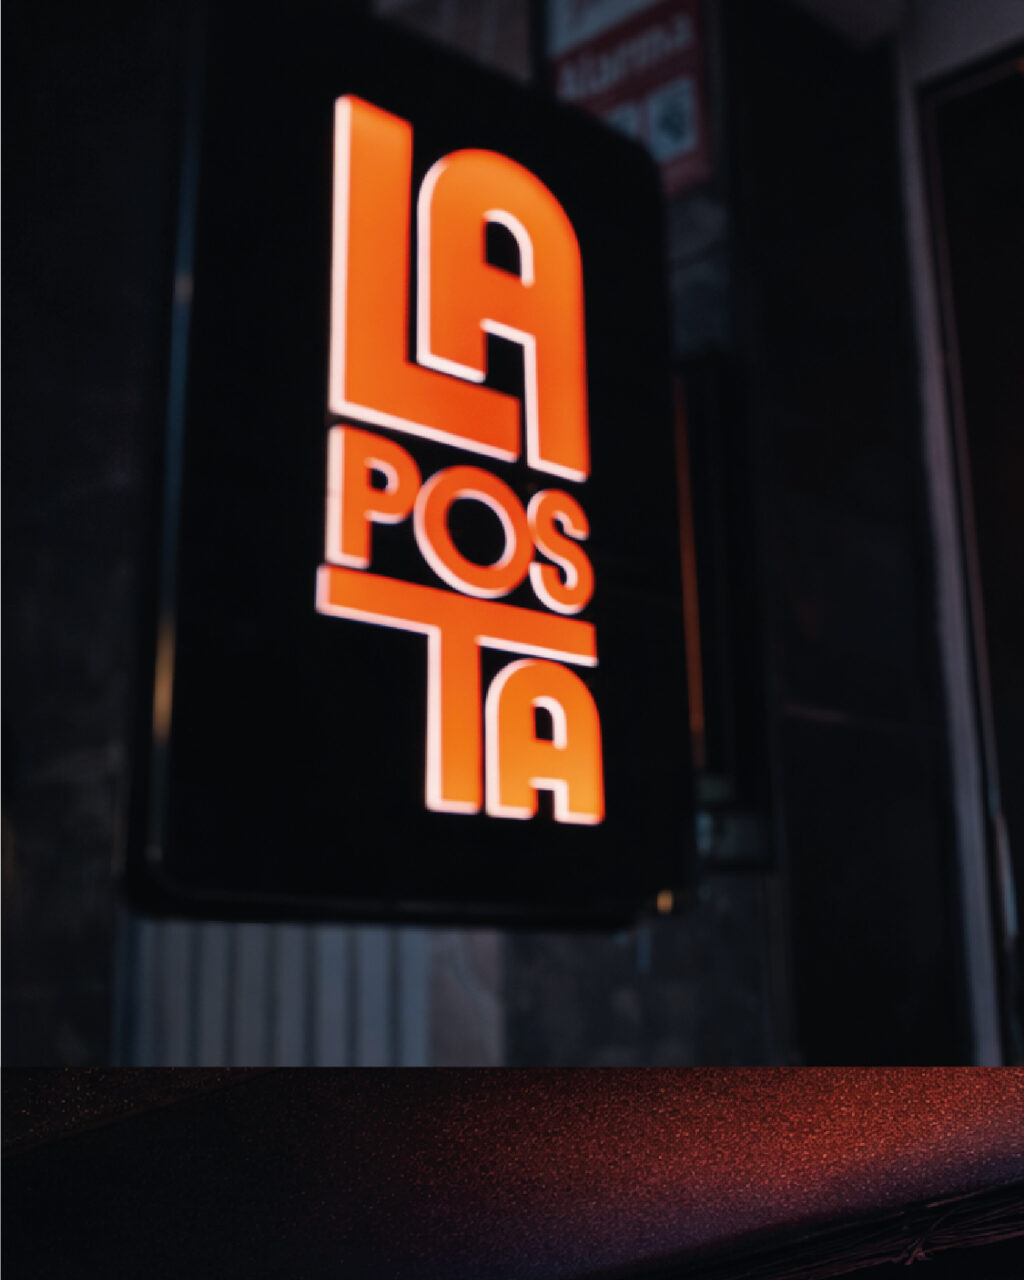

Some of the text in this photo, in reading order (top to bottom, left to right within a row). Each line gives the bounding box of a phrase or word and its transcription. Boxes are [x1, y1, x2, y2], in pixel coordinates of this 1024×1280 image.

[330, 93, 592, 483] LA
[325, 424, 596, 616] POS
[315, 564, 606, 826] TA
